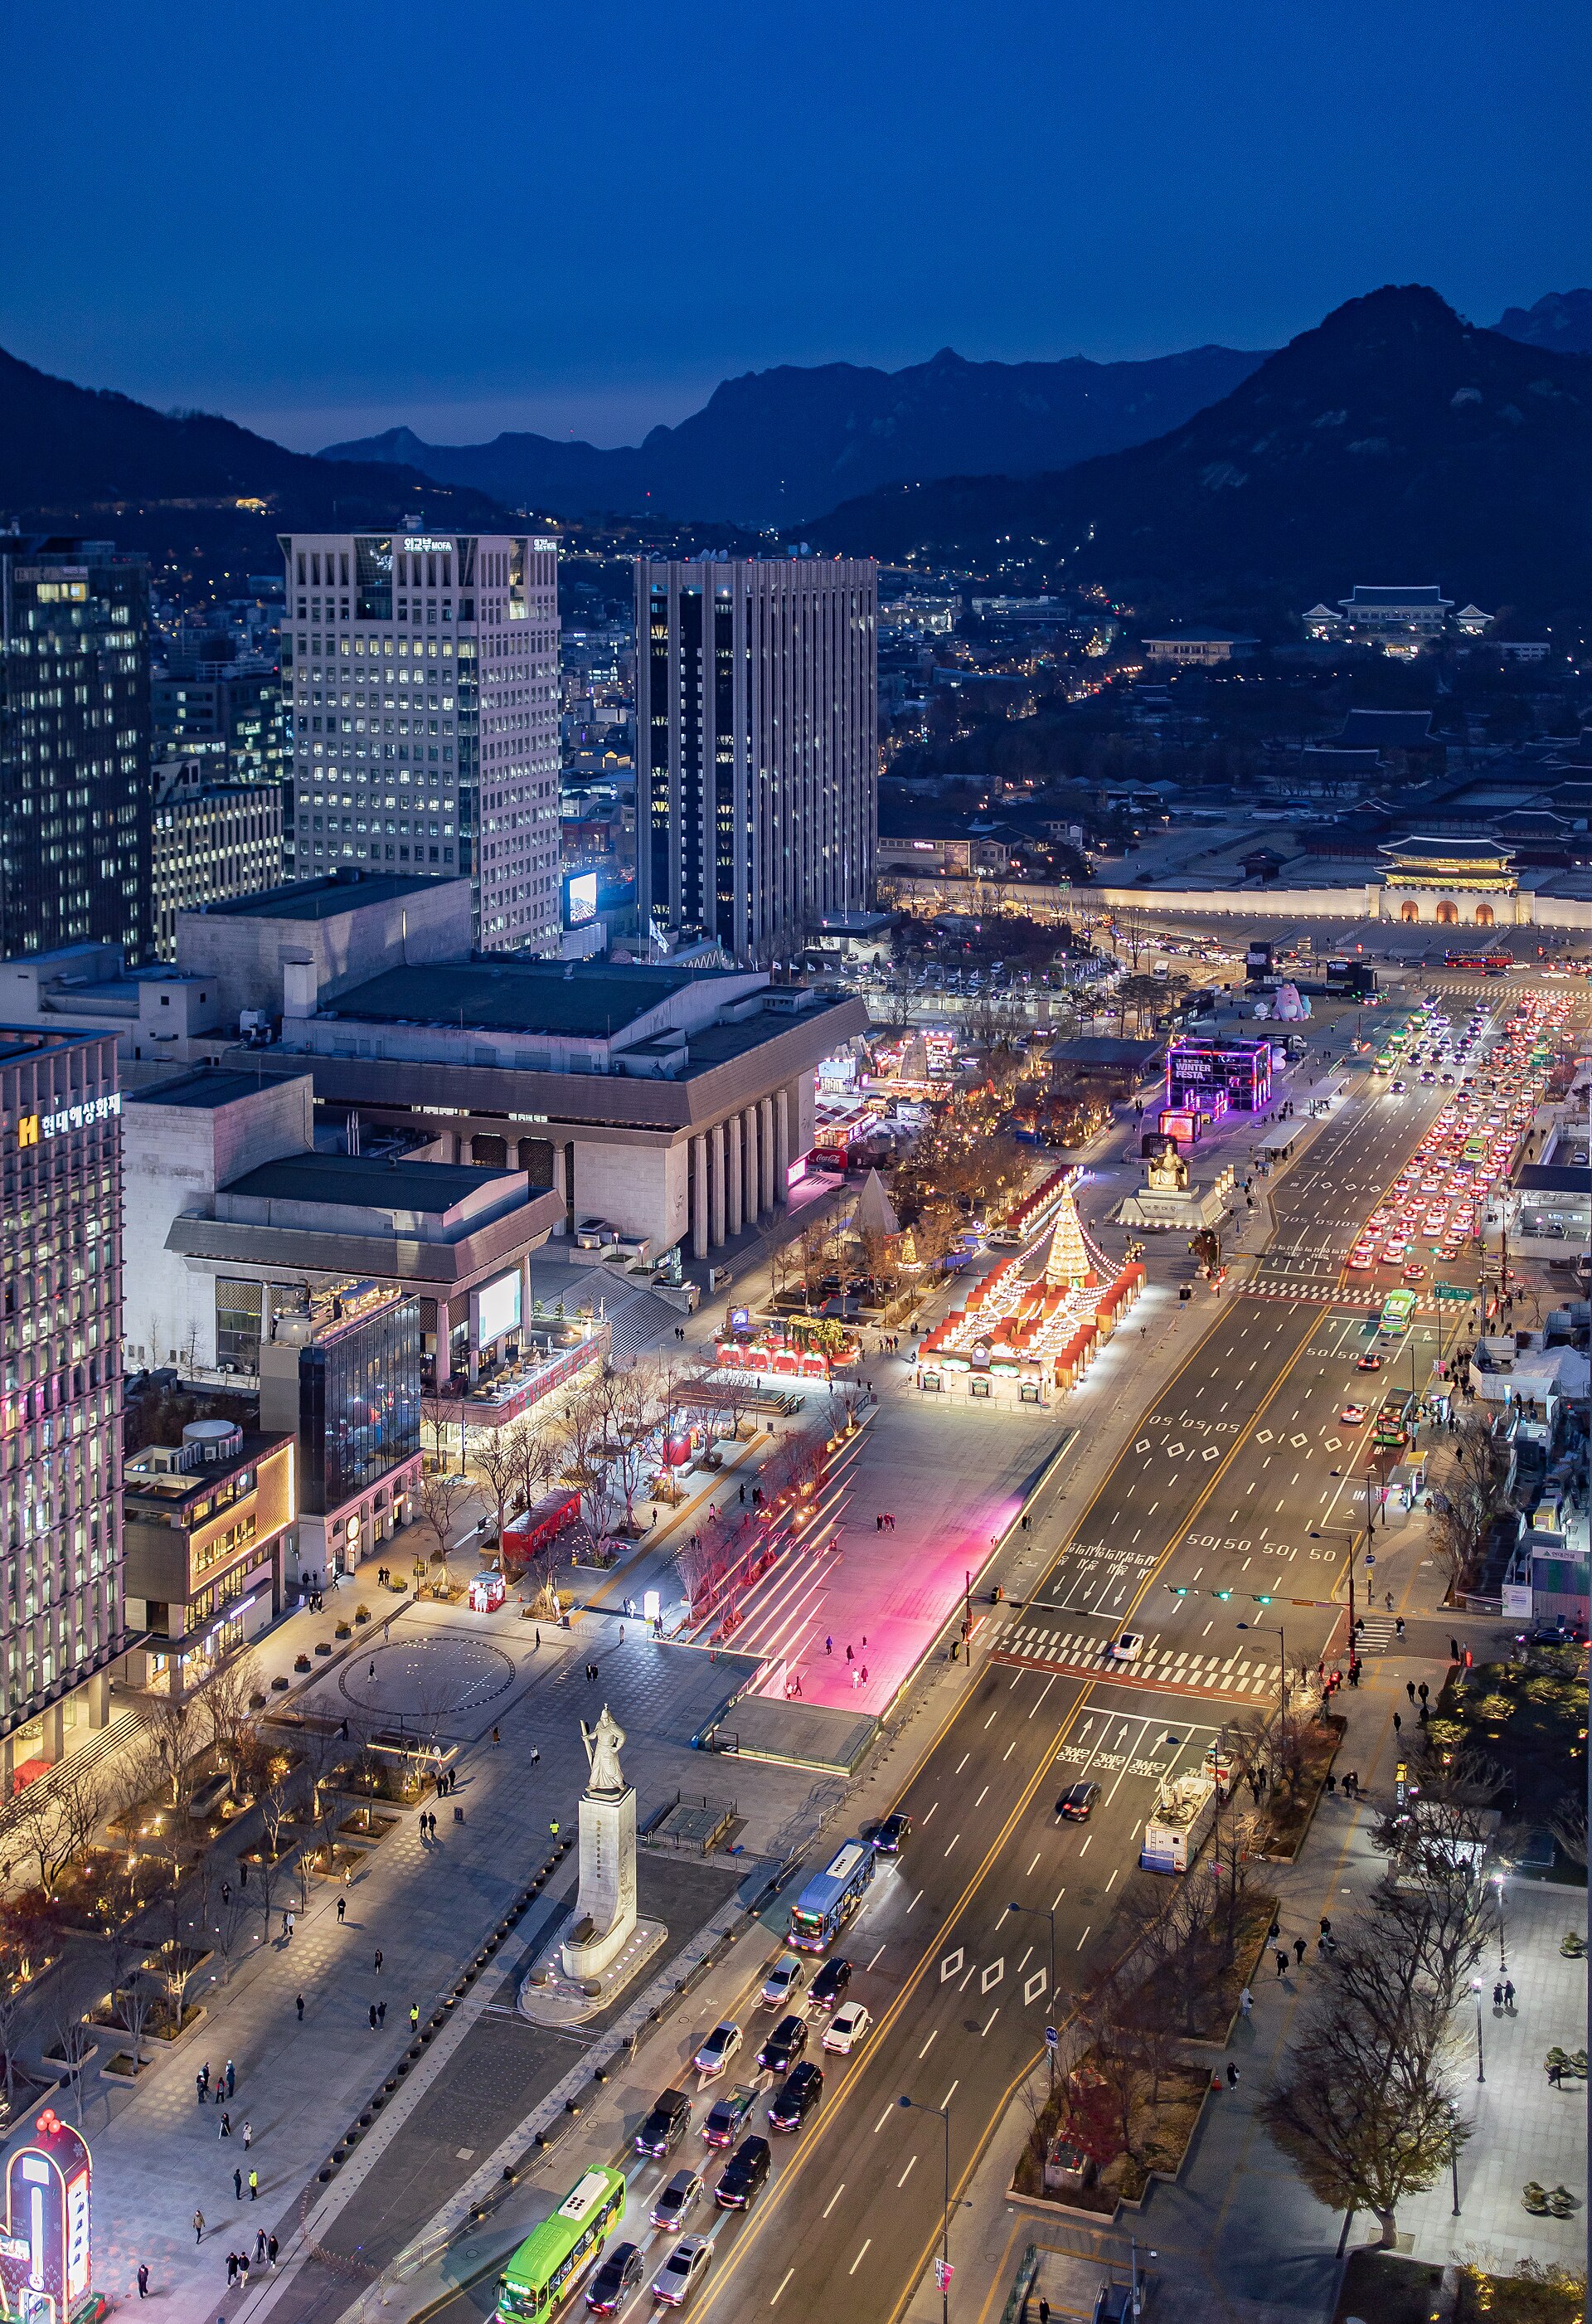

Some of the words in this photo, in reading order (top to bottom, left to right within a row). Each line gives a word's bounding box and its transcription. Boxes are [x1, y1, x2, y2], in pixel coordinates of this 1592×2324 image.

[404, 537, 431, 552] 외교부
[431, 542, 453, 551] MOFA
[1176, 1062, 1211, 1072] WINTER
[1176, 1071, 1204, 1079] FESTA
[41, 1092, 121, 1139] 현대해상화재
[1306, 1348, 1328, 1356] 50
[1337, 1351, 1359, 1360] 50
[1148, 1416, 1173, 1426] 50
[1182, 1419, 1206, 1429] 50
[1216, 1422, 1240, 1433] 50
[1187, 1534, 1214, 1547] 50
[1223, 1539, 1252, 1551] 50
[1262, 1543, 1290, 1556] 50
[1309, 1549, 1337, 1562] 50
[1056, 1745, 1091, 1765] 광화문
[1092, 1752, 1126, 1772] 광화문
[1128, 1758, 1167, 1779] 광화문
